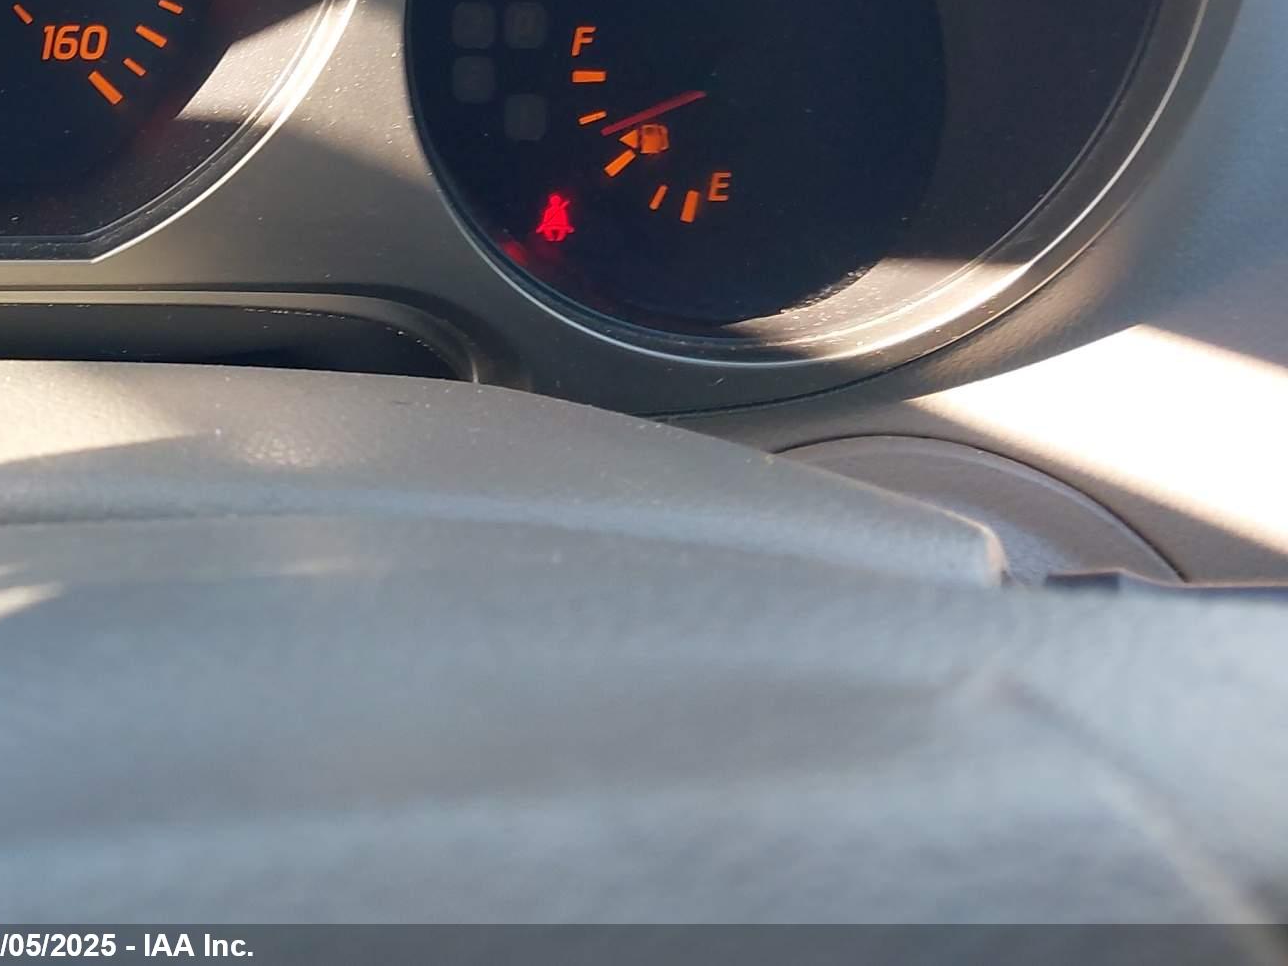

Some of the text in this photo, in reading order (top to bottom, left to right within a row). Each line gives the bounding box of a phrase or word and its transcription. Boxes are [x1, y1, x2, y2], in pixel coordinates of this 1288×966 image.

[41, 25, 108, 61] 160
[572, 26, 596, 56] F
[708, 172, 731, 201] E
